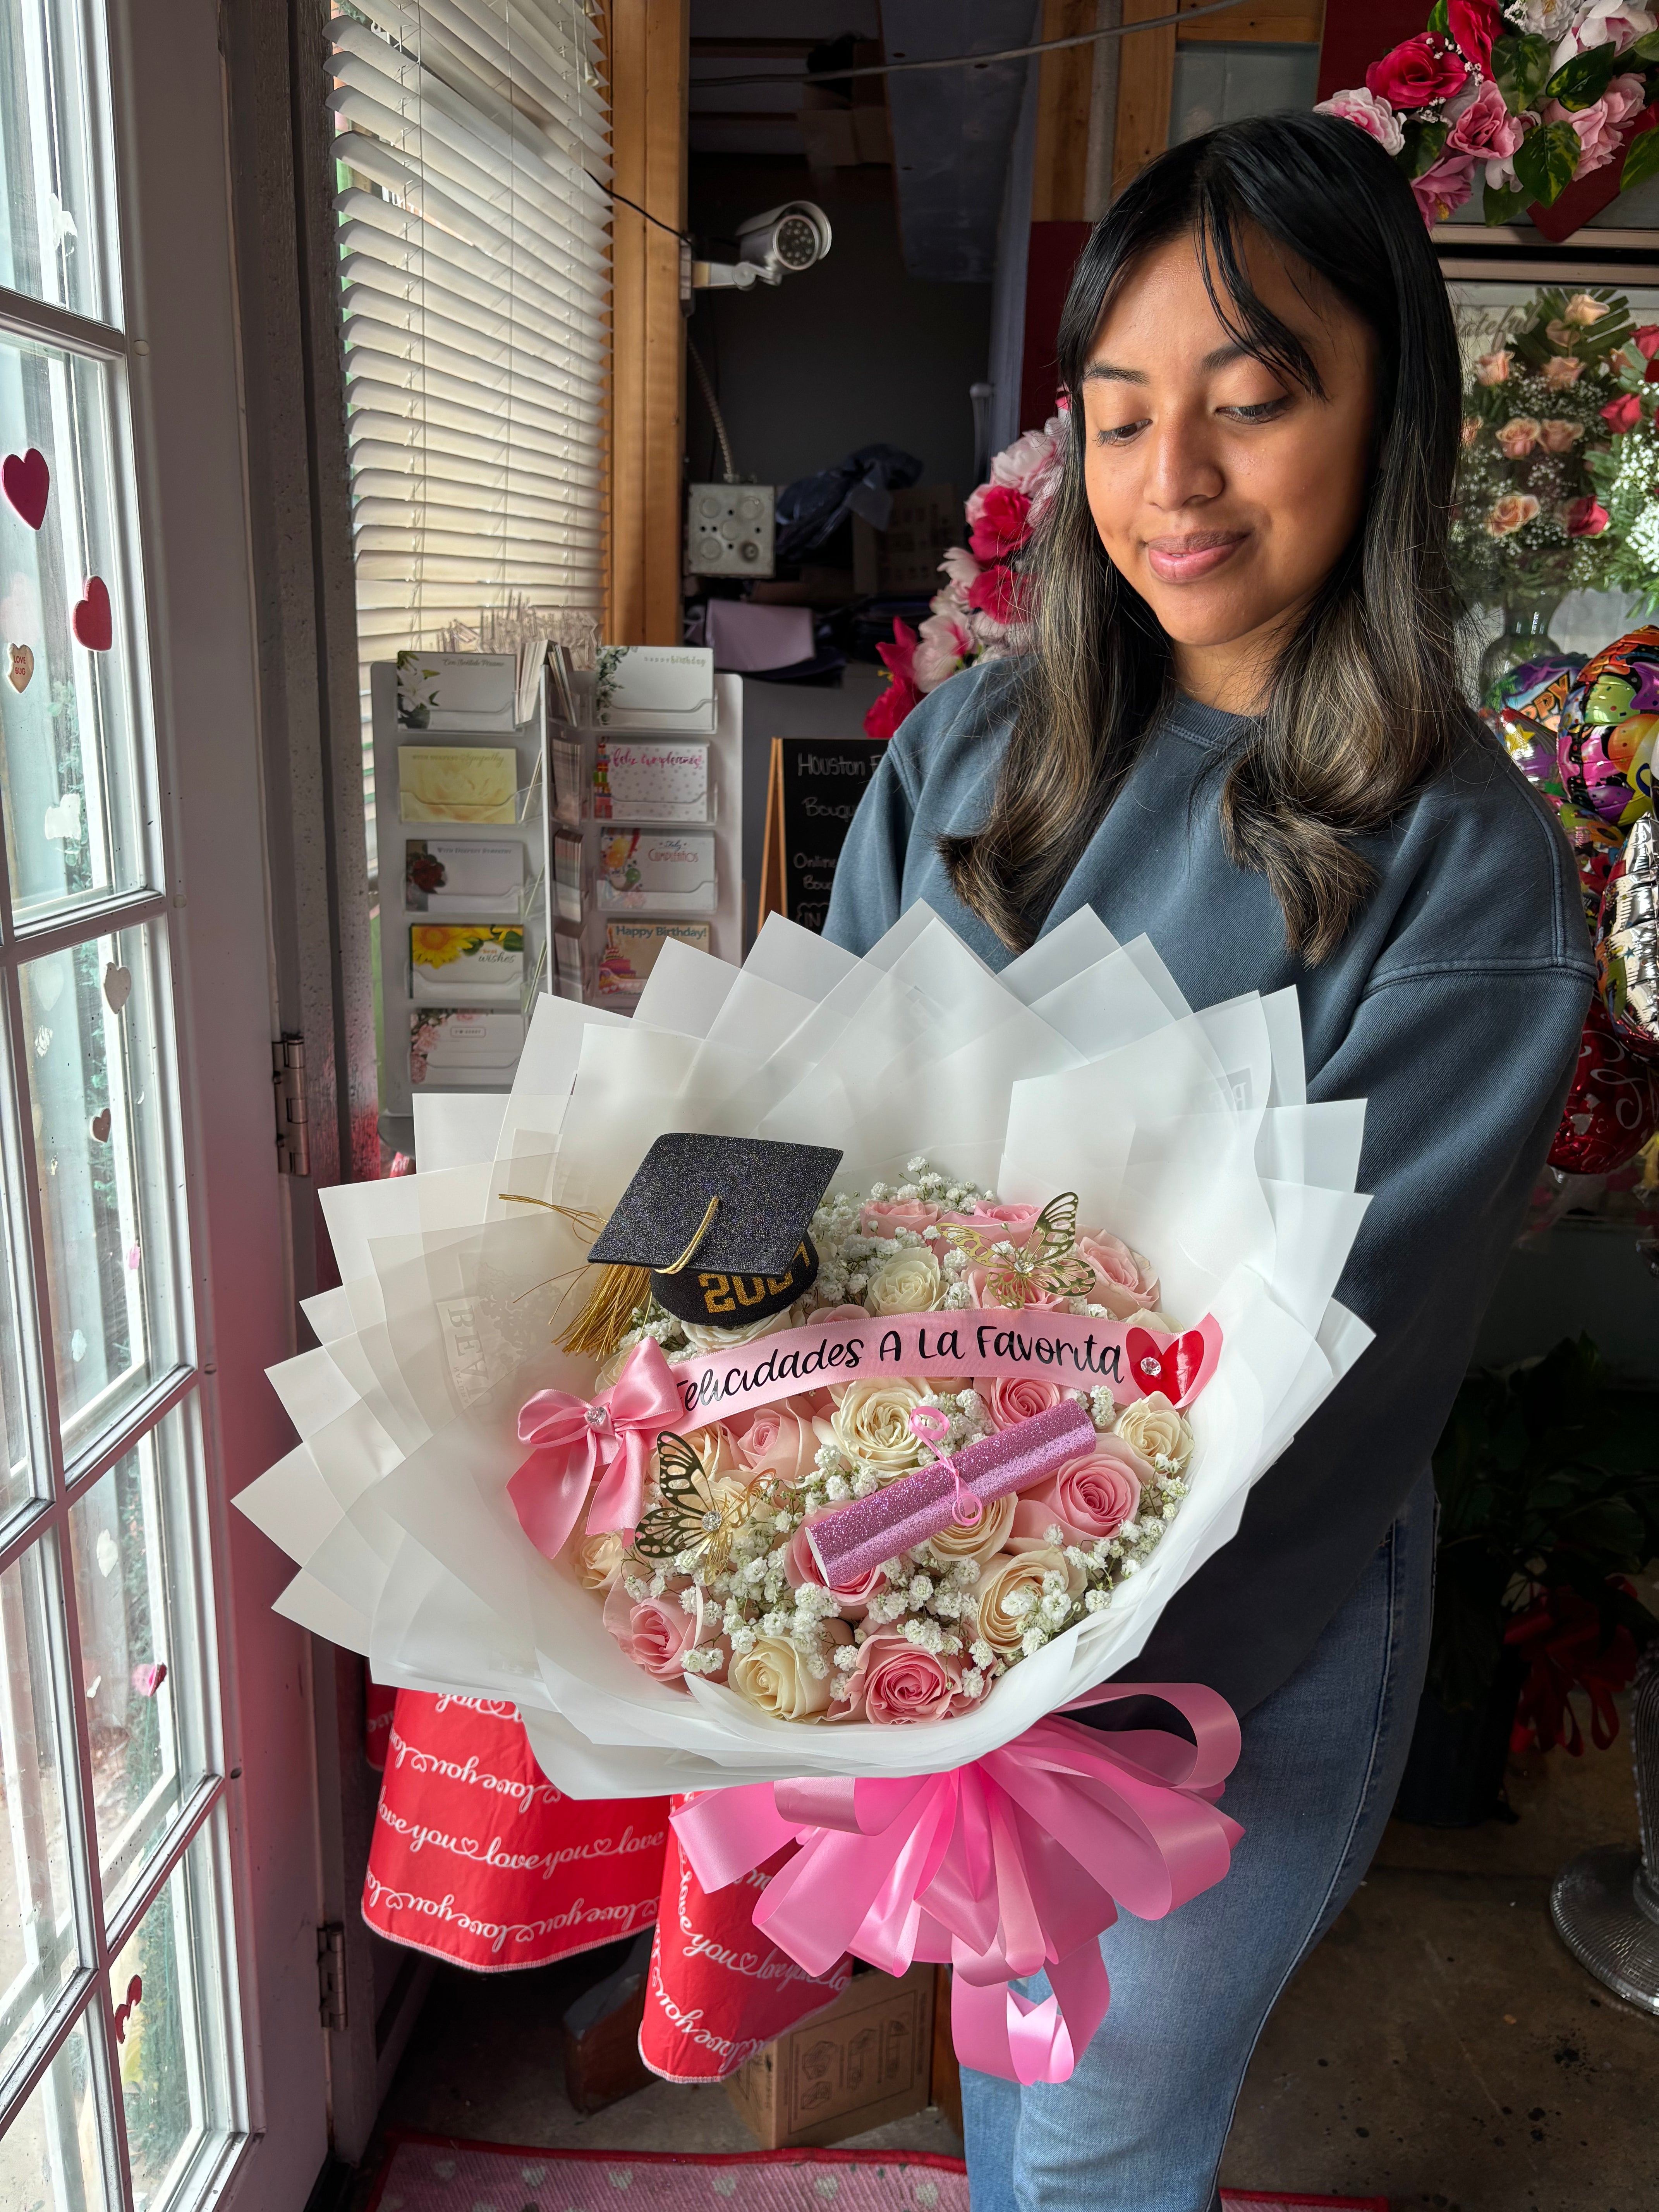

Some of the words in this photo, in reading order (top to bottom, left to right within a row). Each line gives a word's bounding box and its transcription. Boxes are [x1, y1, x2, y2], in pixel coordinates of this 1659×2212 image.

[14, 655, 26, 664] LOVE
[15, 667, 26, 675] BUG
[616, 926, 653, 939] Happy
[656, 927, 707, 940] Birthday!
[478, 951, 516, 963] wishes
[880, 1330, 902, 1362] A
[919, 1328, 966, 1360] La
[976, 1325, 1125, 1384] Favorita
